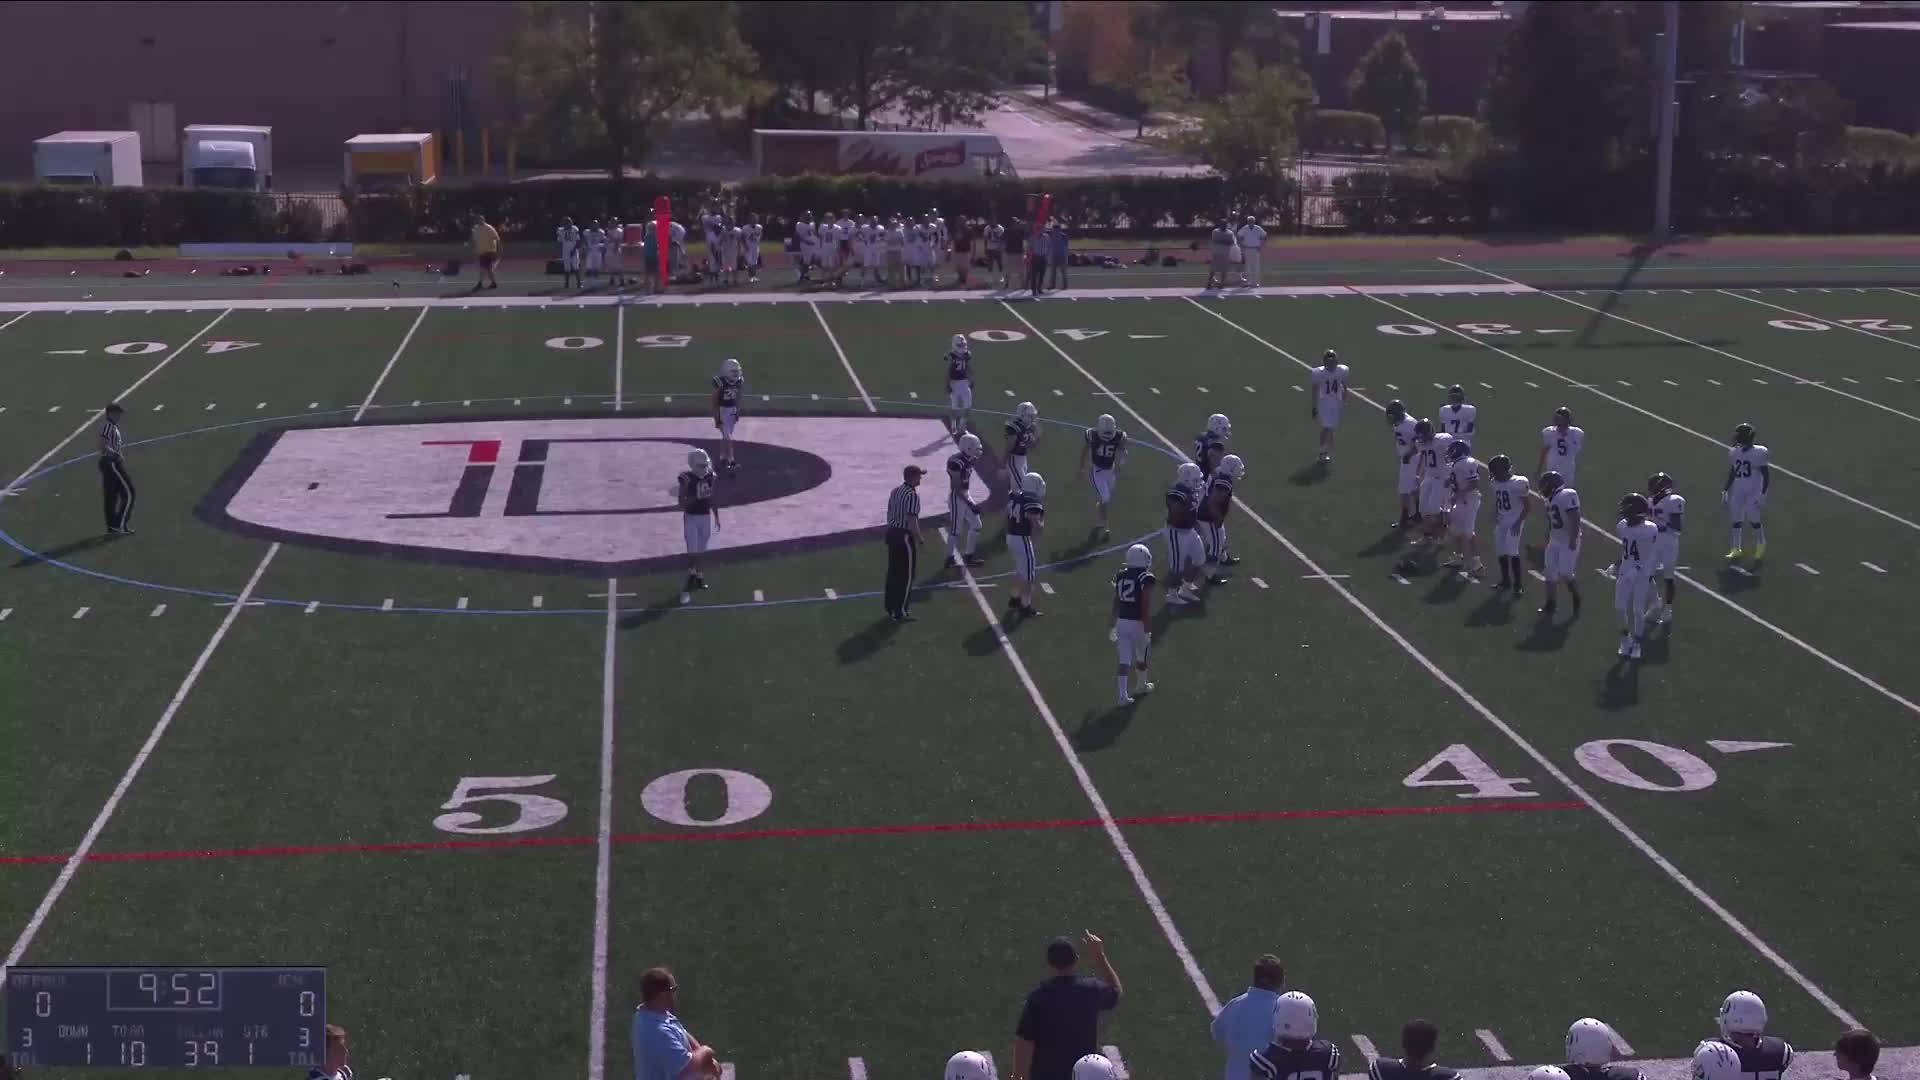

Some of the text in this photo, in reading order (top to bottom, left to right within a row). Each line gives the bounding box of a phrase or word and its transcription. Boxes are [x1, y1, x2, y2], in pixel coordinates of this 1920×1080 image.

[1325, 379, 1338, 394] 14
[1557, 438, 1567, 456] 5
[1735, 459, 1752, 477] 23
[1117, 578, 1136, 603] 12
